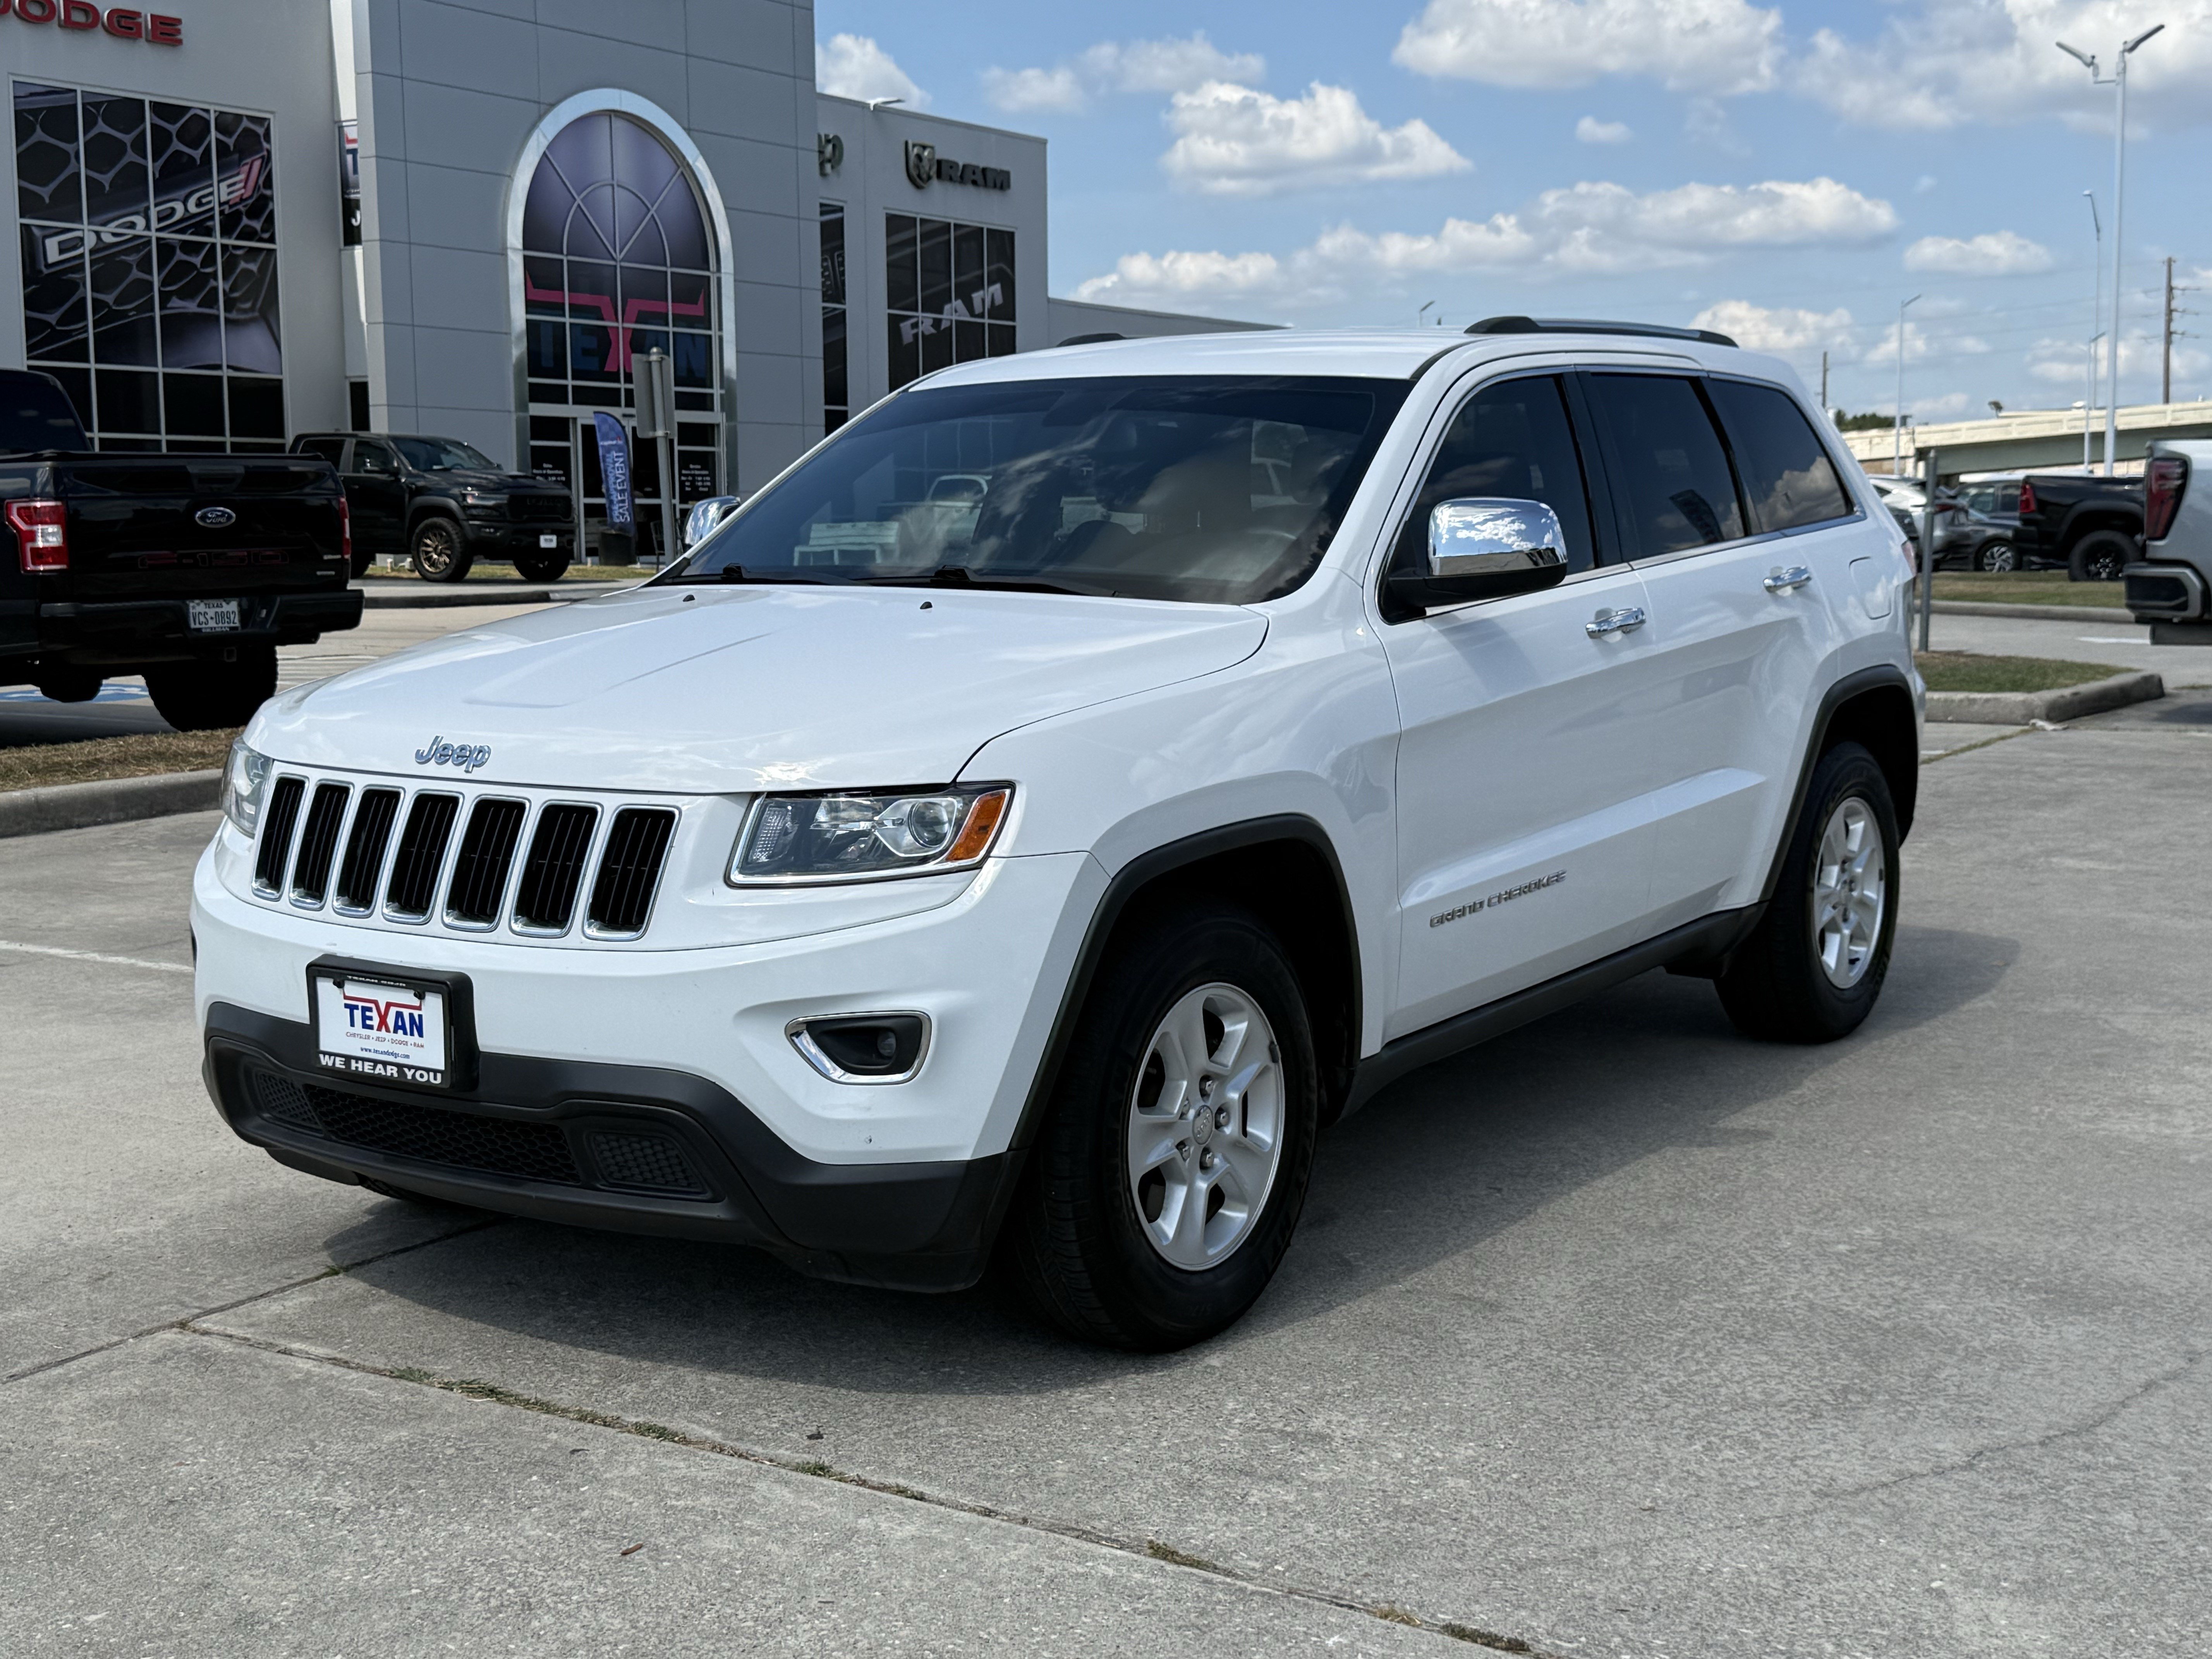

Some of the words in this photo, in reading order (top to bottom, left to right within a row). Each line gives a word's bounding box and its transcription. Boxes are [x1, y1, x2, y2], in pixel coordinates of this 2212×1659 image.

[0, 0, 183, 46] ODGE
[936, 159, 1011, 191] RAM
[45, 174, 245, 264] DODGE
[526, 270, 707, 378] TEXAN
[900, 282, 1003, 347] RAM
[613, 452, 627, 490] EVENT
[206, 512, 228, 522] Ford
[618, 492, 630, 522] SALE
[415, 735, 491, 773] Jeep
[1430, 898, 1485, 927] GRAND
[1487, 868, 1567, 907] CHEROKEE
[343, 989, 424, 1038] TEXAN
[319, 1053, 345, 1069] WE
[350, 1059, 398, 1078] HEAR
[403, 1068, 441, 1084] YOU
